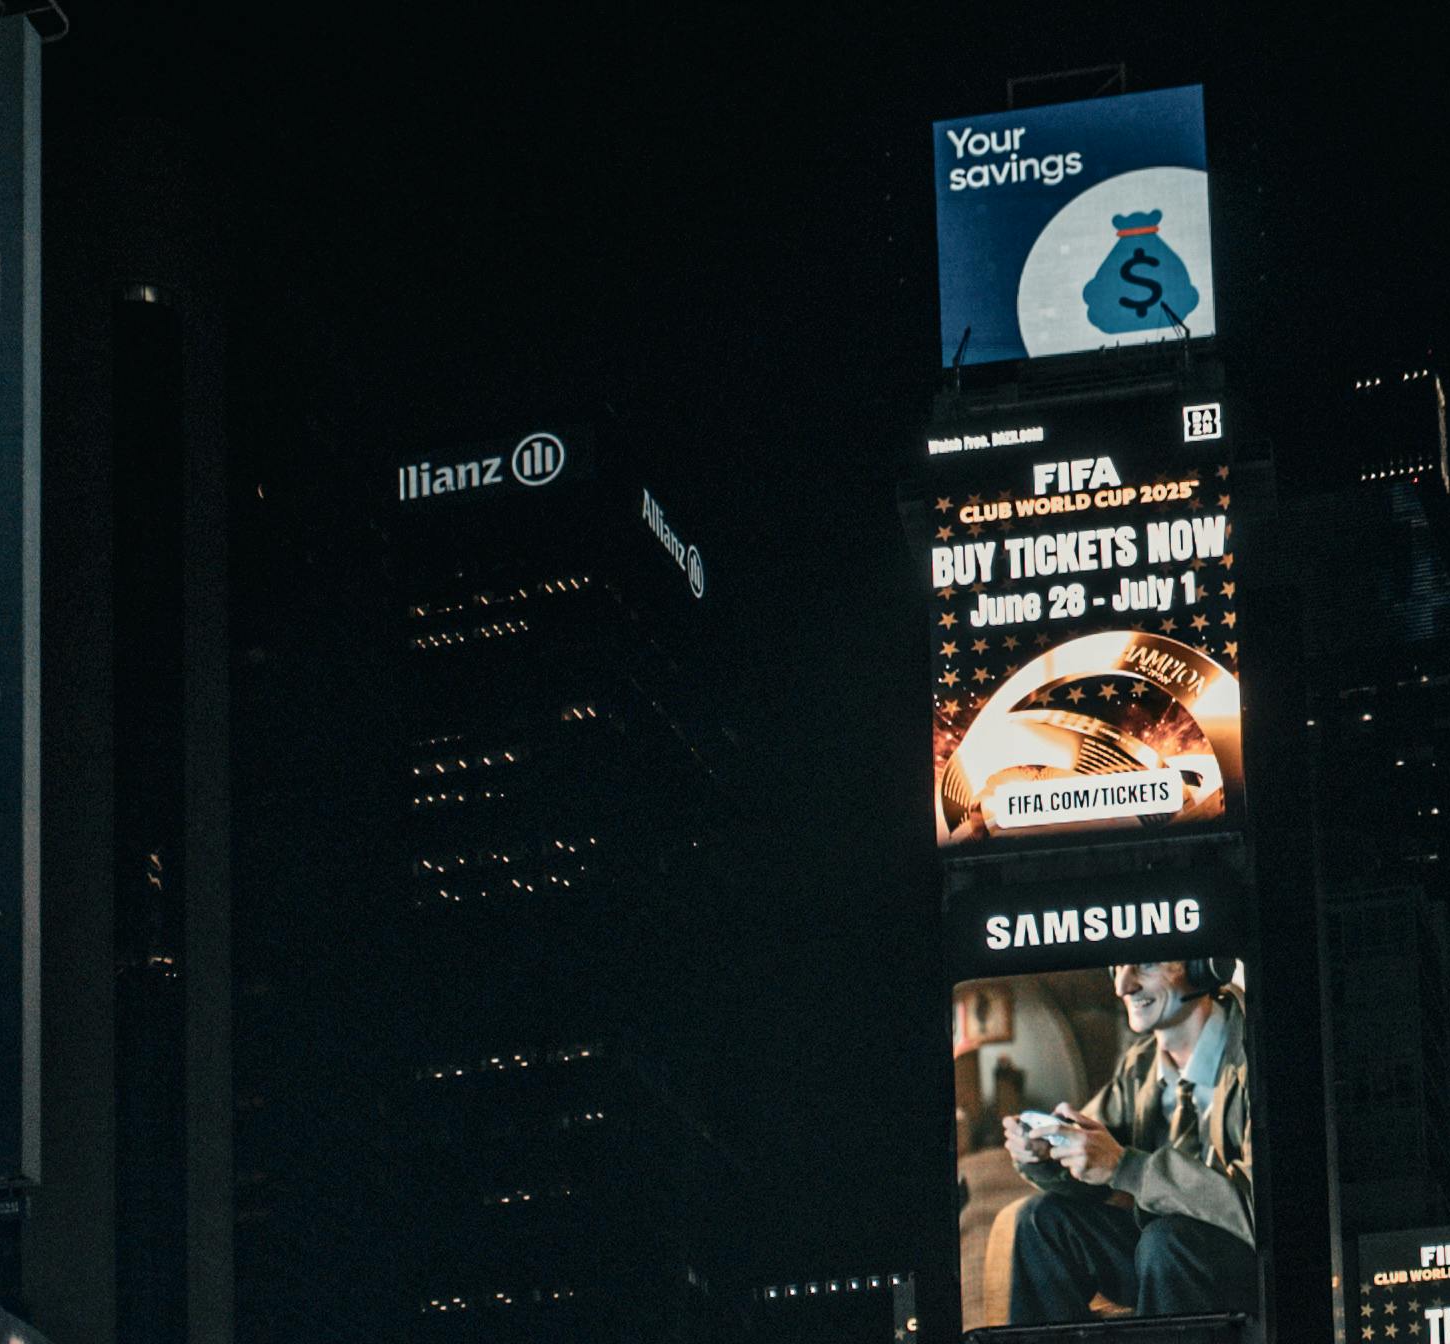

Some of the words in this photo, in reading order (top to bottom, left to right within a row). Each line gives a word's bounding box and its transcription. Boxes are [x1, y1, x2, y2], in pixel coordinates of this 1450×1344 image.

[947, 124, 1026, 158] Your
[950, 151, 1083, 193] savings
[1033, 456, 1122, 495] FIFA
[959, 503, 1013, 524] CLUB
[1015, 493, 1092, 518] WORLD
[1094, 487, 1137, 509] CUP
[642, 487, 686, 572] Allianz
[932, 540, 997, 589] BUY
[1004, 525, 1138, 580] TICKETS
[1146, 514, 1226, 564] NOW
[970, 592, 1042, 628] June
[1048, 583, 1086, 620] 28
[1112, 574, 1174, 612] July
[1180, 570, 1197, 605] 1
[1007, 780, 1170, 816] FIFA.COM/TICKETS
[986, 897, 1200, 951] SAMSUNG
[1374, 1268, 1409, 1286] CLUB
